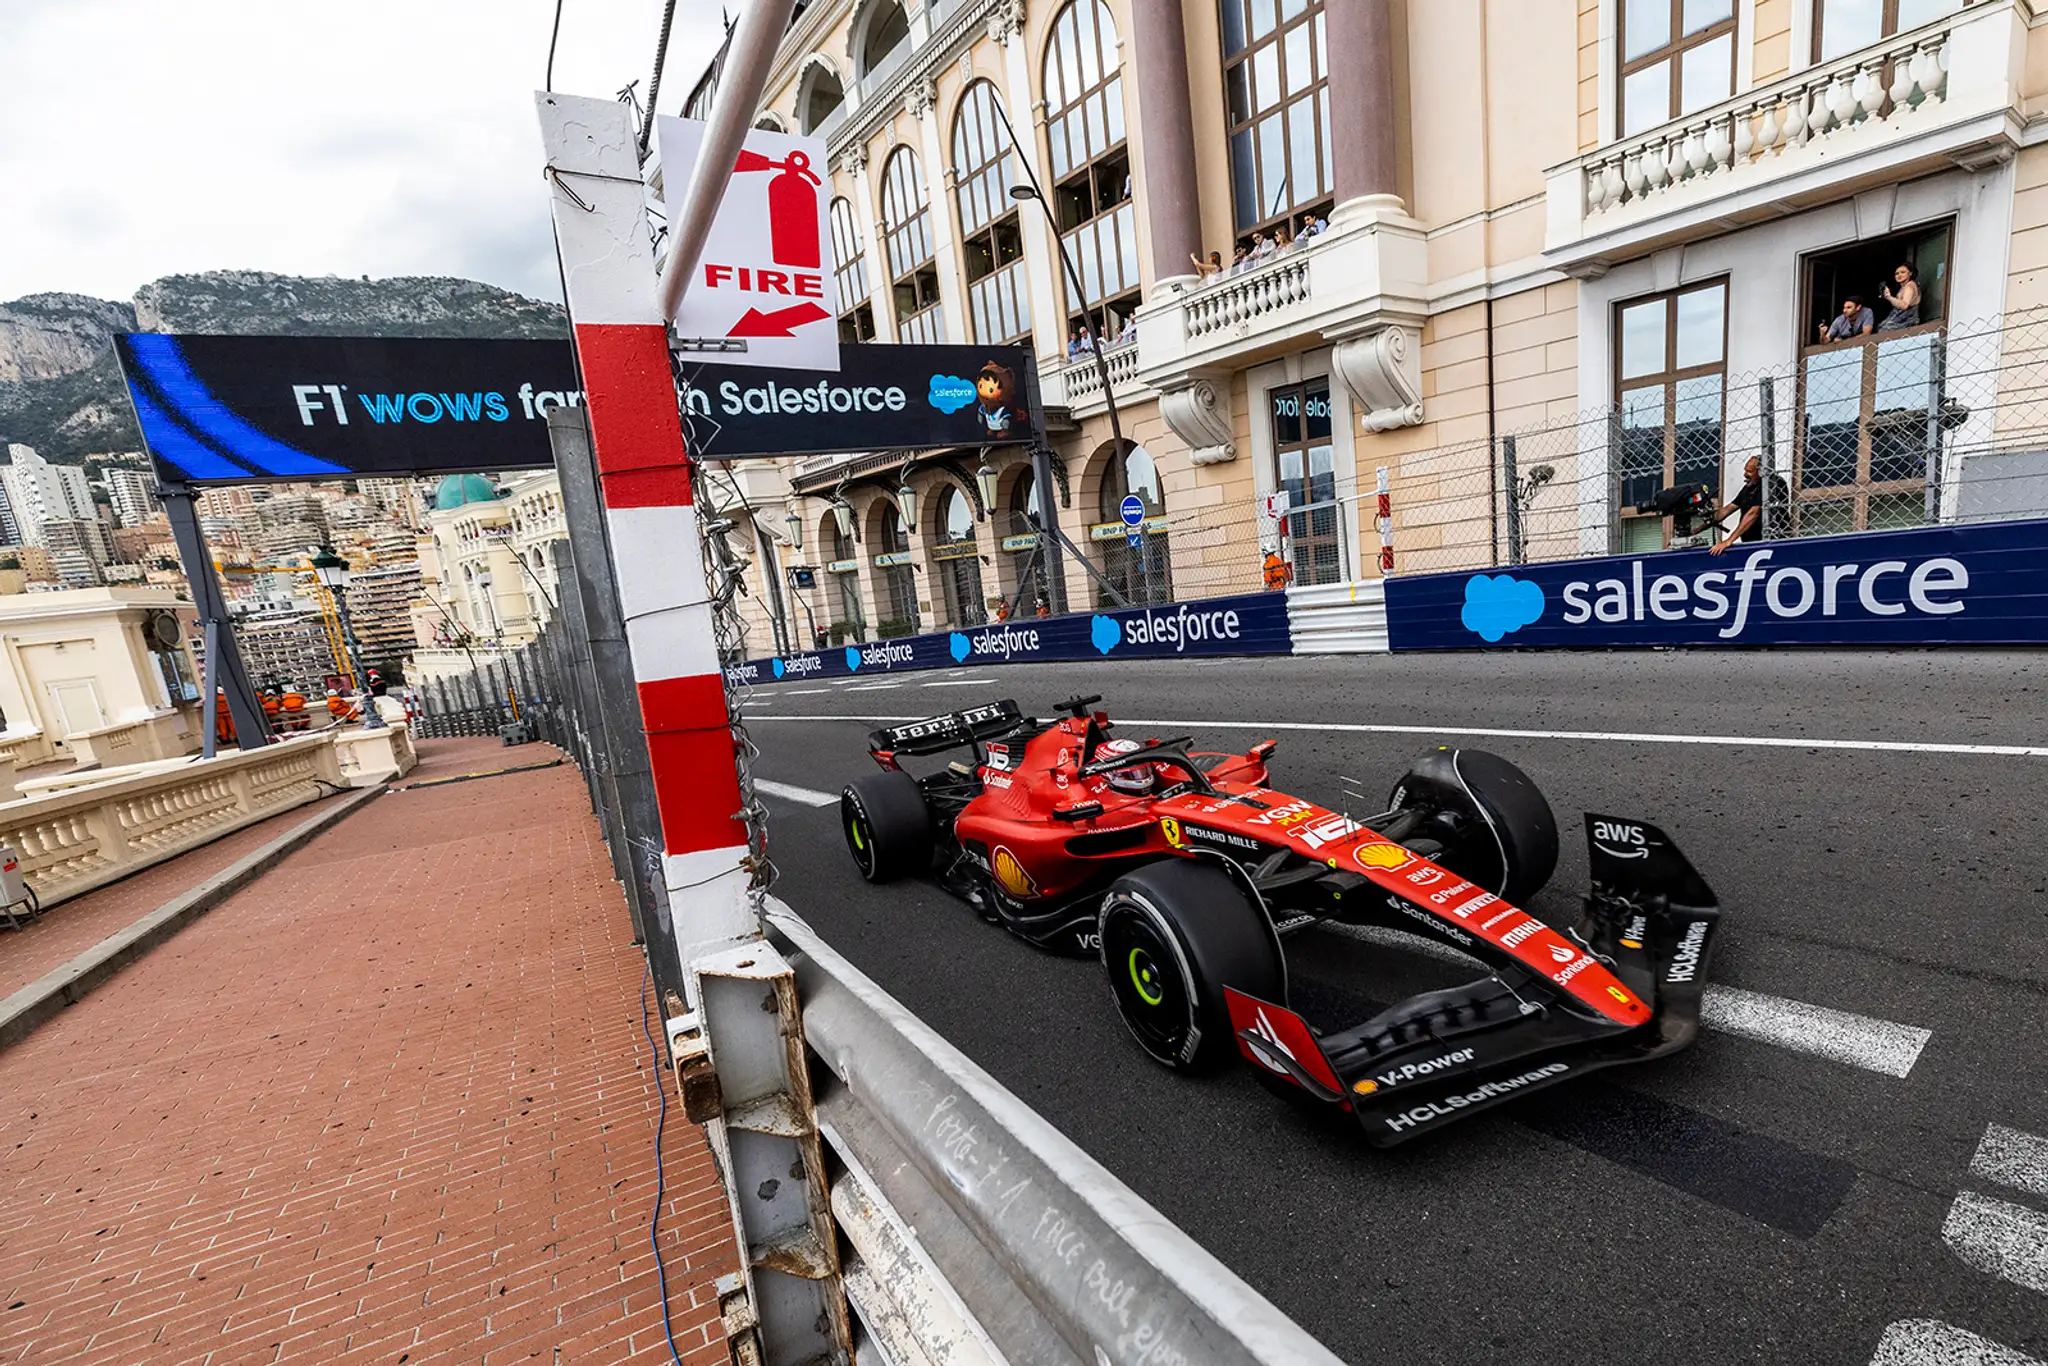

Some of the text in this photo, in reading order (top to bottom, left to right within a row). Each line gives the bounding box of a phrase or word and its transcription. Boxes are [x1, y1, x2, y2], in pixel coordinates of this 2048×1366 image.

[704, 263, 824, 298] FIRE
[292, 384, 349, 426] F1
[719, 379, 908, 416] Salesforce
[934, 387, 973, 399] salesforce
[1562, 549, 1970, 639] salesforce
[972, 625, 1040, 661] salesforce
[1126, 604, 1240, 652] salesforce
[783, 652, 823, 677] salesforce
[861, 641, 914, 669] salesforce
[891, 703, 1001, 742] Ferrri
[985, 741, 1010, 771] 16
[1246, 799, 1313, 826] VGW
[1276, 808, 1314, 827] PLAY
[1184, 825, 1259, 850] RICHARD MILLE
[1286, 812, 1364, 850] 16
[1593, 821, 1646, 846] aws
[1405, 866, 1438, 883] aws
[1075, 933, 1101, 949] VG
[1400, 901, 1474, 947] Santander
[1666, 921, 1709, 983] HCLSoftware
[1376, 1047, 1476, 1087] V-Power
[1384, 1062, 1571, 1133] HCLSoftware
